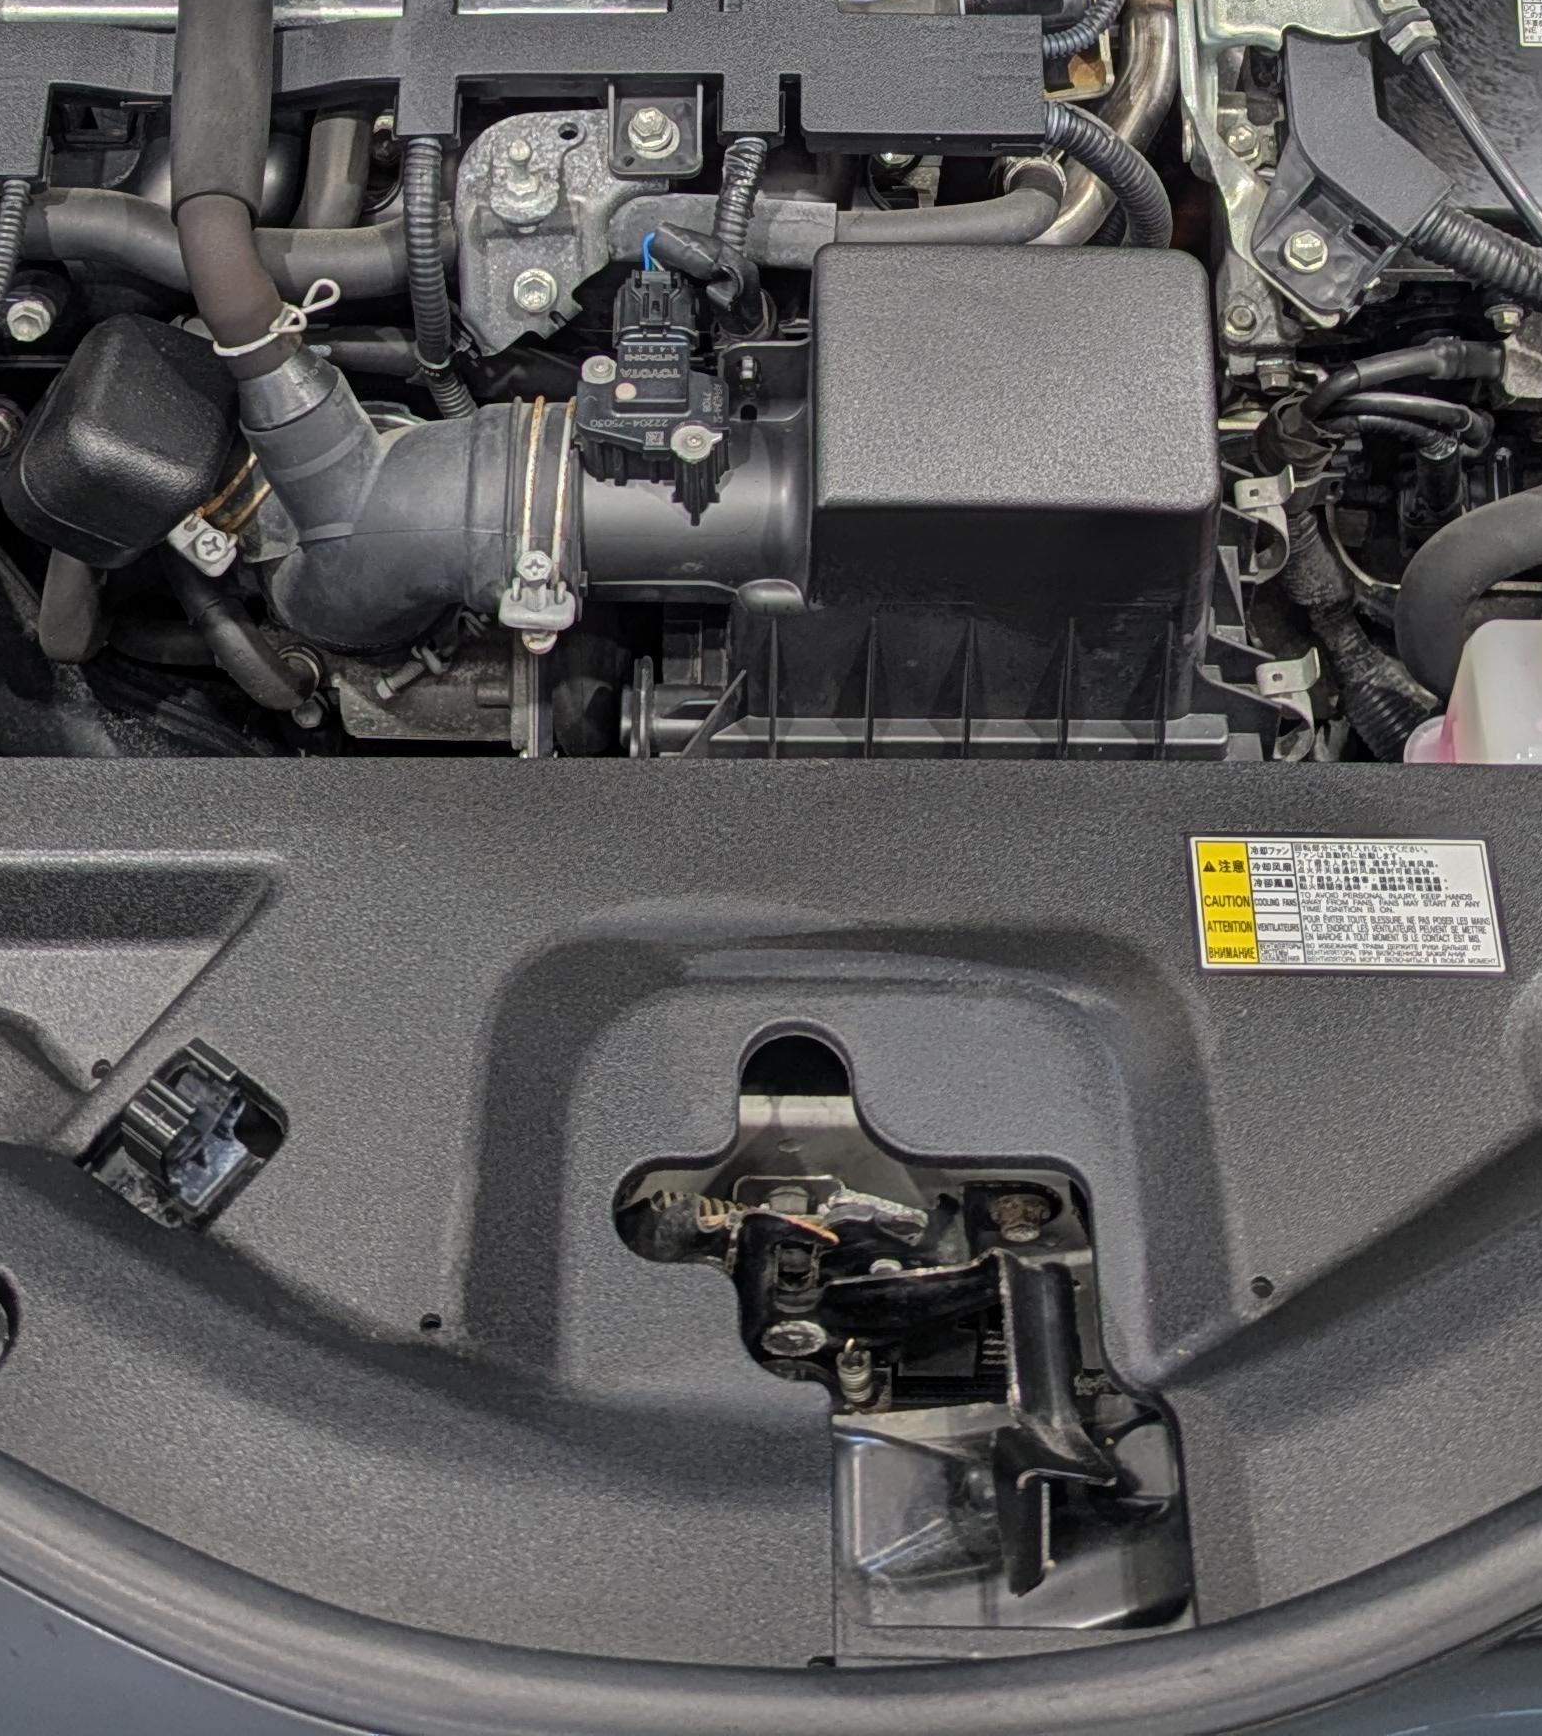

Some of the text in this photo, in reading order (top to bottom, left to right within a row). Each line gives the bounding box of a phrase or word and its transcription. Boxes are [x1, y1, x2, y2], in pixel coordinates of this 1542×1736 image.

[619, 368, 681, 379] TOYOTA
[590, 418, 669, 428] 22204-75030
[1250, 846, 1290, 855] 冷却ファン
[1219, 860, 1245, 873] 注意
[1343, 892, 1383, 900] PERSONAL
[1204, 895, 1251, 908] CAUTION
[1254, 898, 1297, 906] COOLING FANS
[1303, 915, 1320, 923] POUR
[1347, 915, 1367, 924] TOUTE
[1406, 916, 1415, 924] NE
[1418, 916, 1430, 924] PAS
[1432, 916, 1454, 925] POSER
[1456, 916, 1468, 925] LES
[1471, 917, 1490, 925] MAINS
[1207, 920, 1253, 933] ATTENTION
[1257, 923, 1300, 932] VENTILATEURS
[1311, 924, 1323, 932] CET
[1358, 924, 1369, 932] LES
[1372, 924, 1417, 934] VENTILATEURS
[1419, 925, 1447, 934] PEUVENT
[1450, 925, 1459, 934] SE
[1462, 926, 1487, 934] METTRE
[1316, 933, 1342, 941] MARCHE
[1353, 933, 1369, 941] TOUT
[1372, 933, 1399, 942] MOMENT
[1411, 934, 1419, 942] LE
[1422, 934, 1450, 942] CONTACT
[1454, 934, 1465, 942] EST
[1209, 946, 1256, 960] ВНИМАНИЕ
